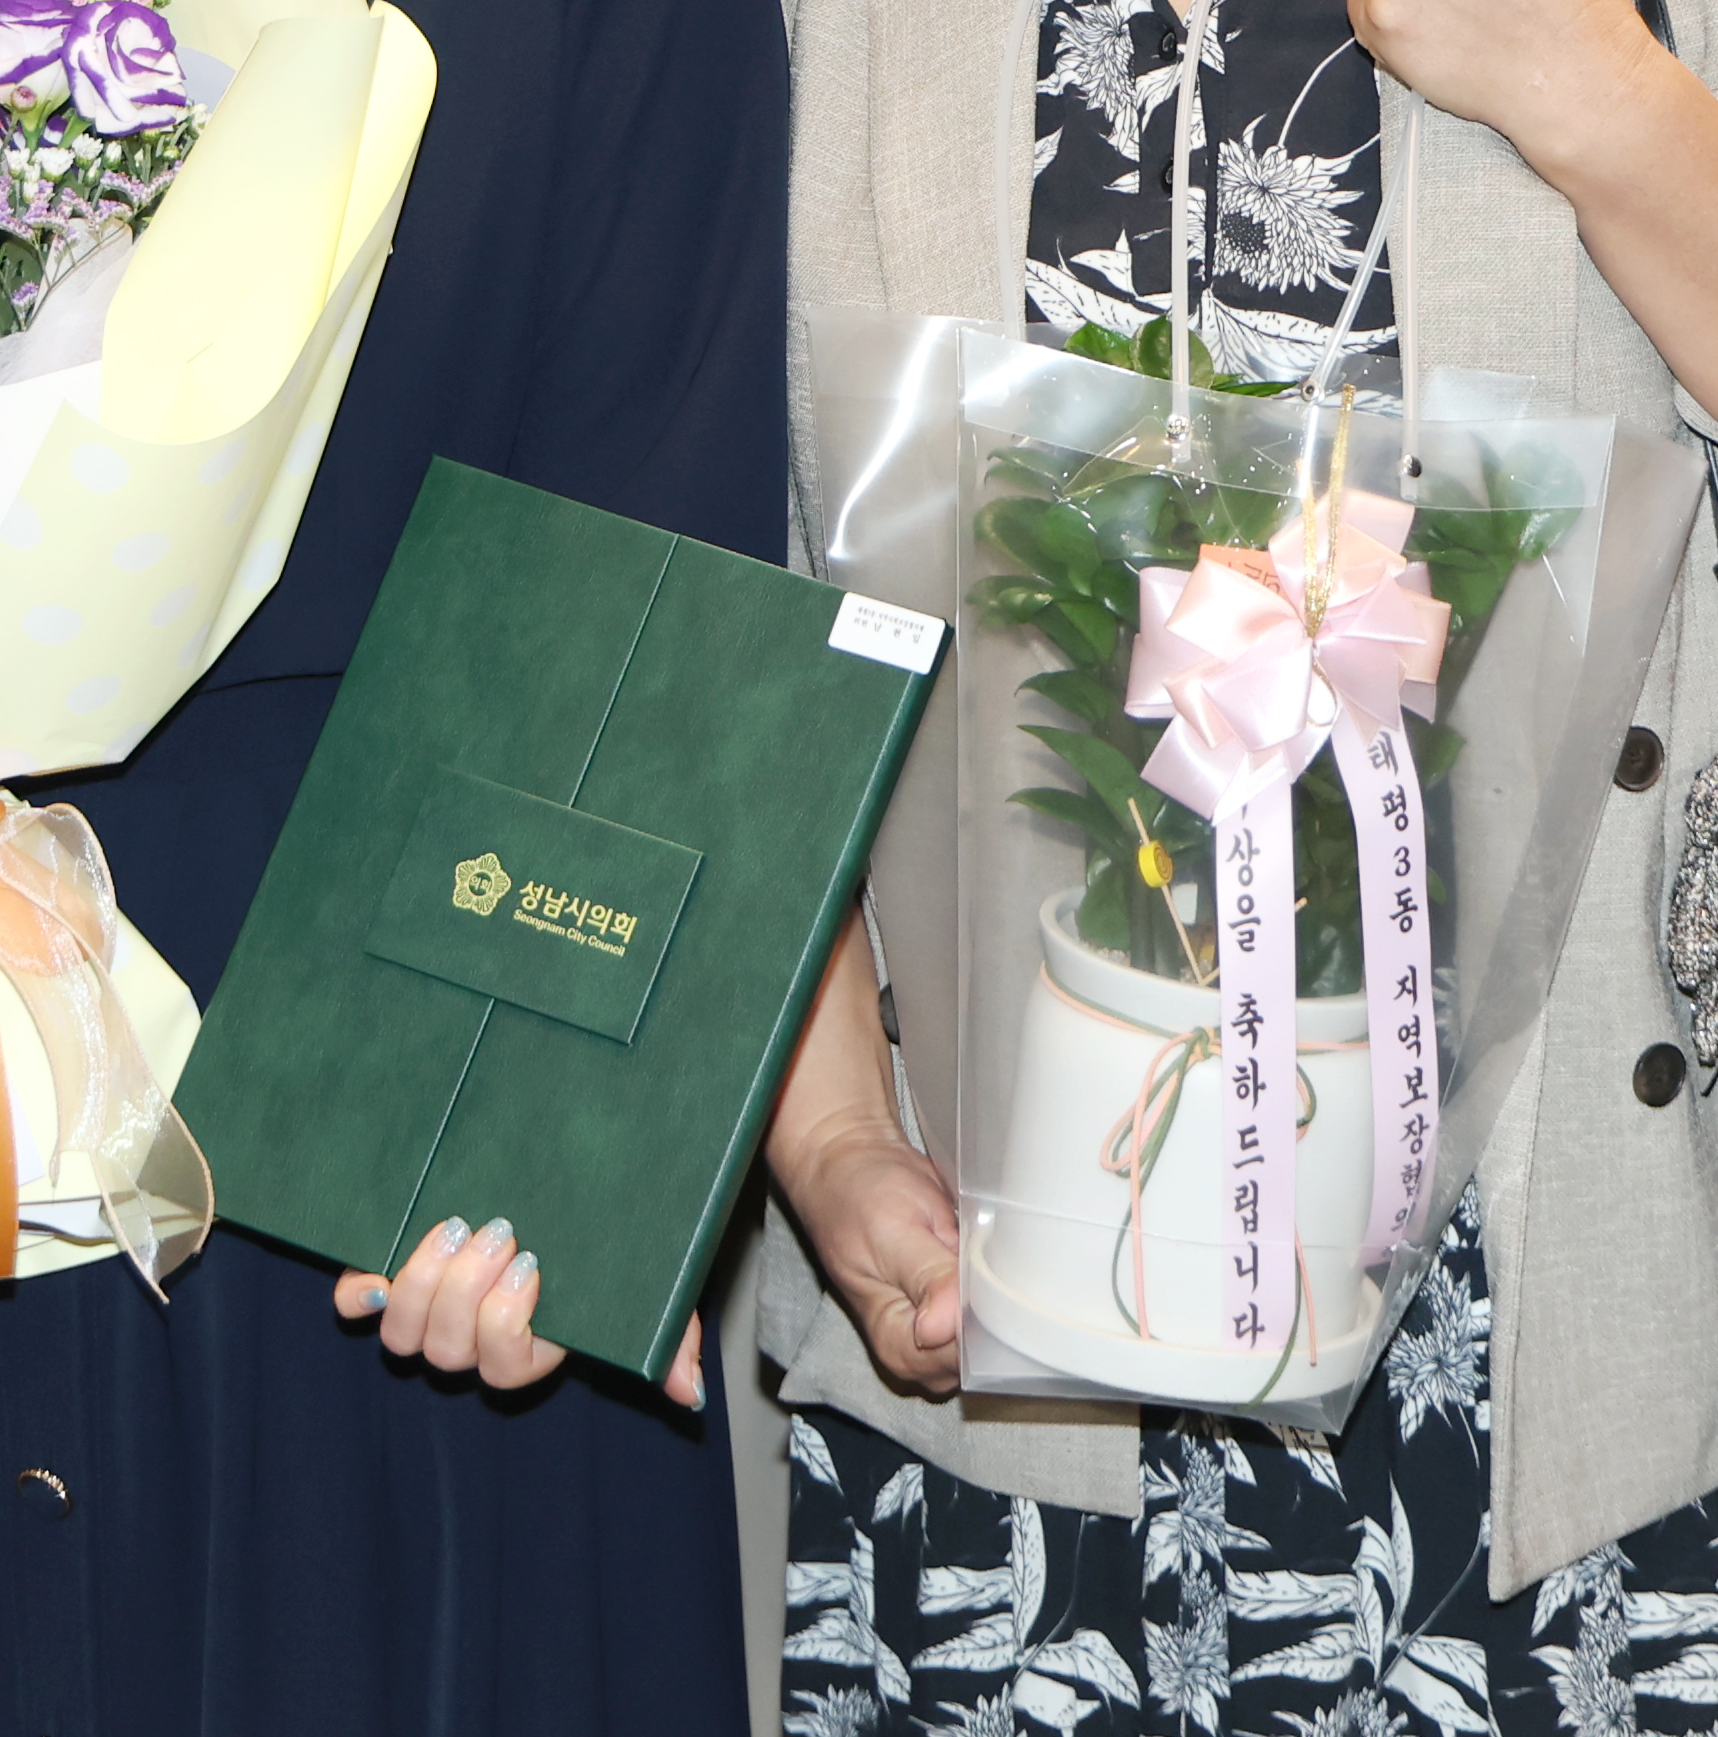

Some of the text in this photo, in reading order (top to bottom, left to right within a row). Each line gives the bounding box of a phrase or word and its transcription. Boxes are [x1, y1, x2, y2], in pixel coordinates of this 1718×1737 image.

[1366, 730, 1418, 933] 태평3동
[513, 908, 627, 958] Seongnam City Council
[519, 880, 638, 945] 성남시의회
[1226, 803, 1267, 1350] 상을 축하드립니다
